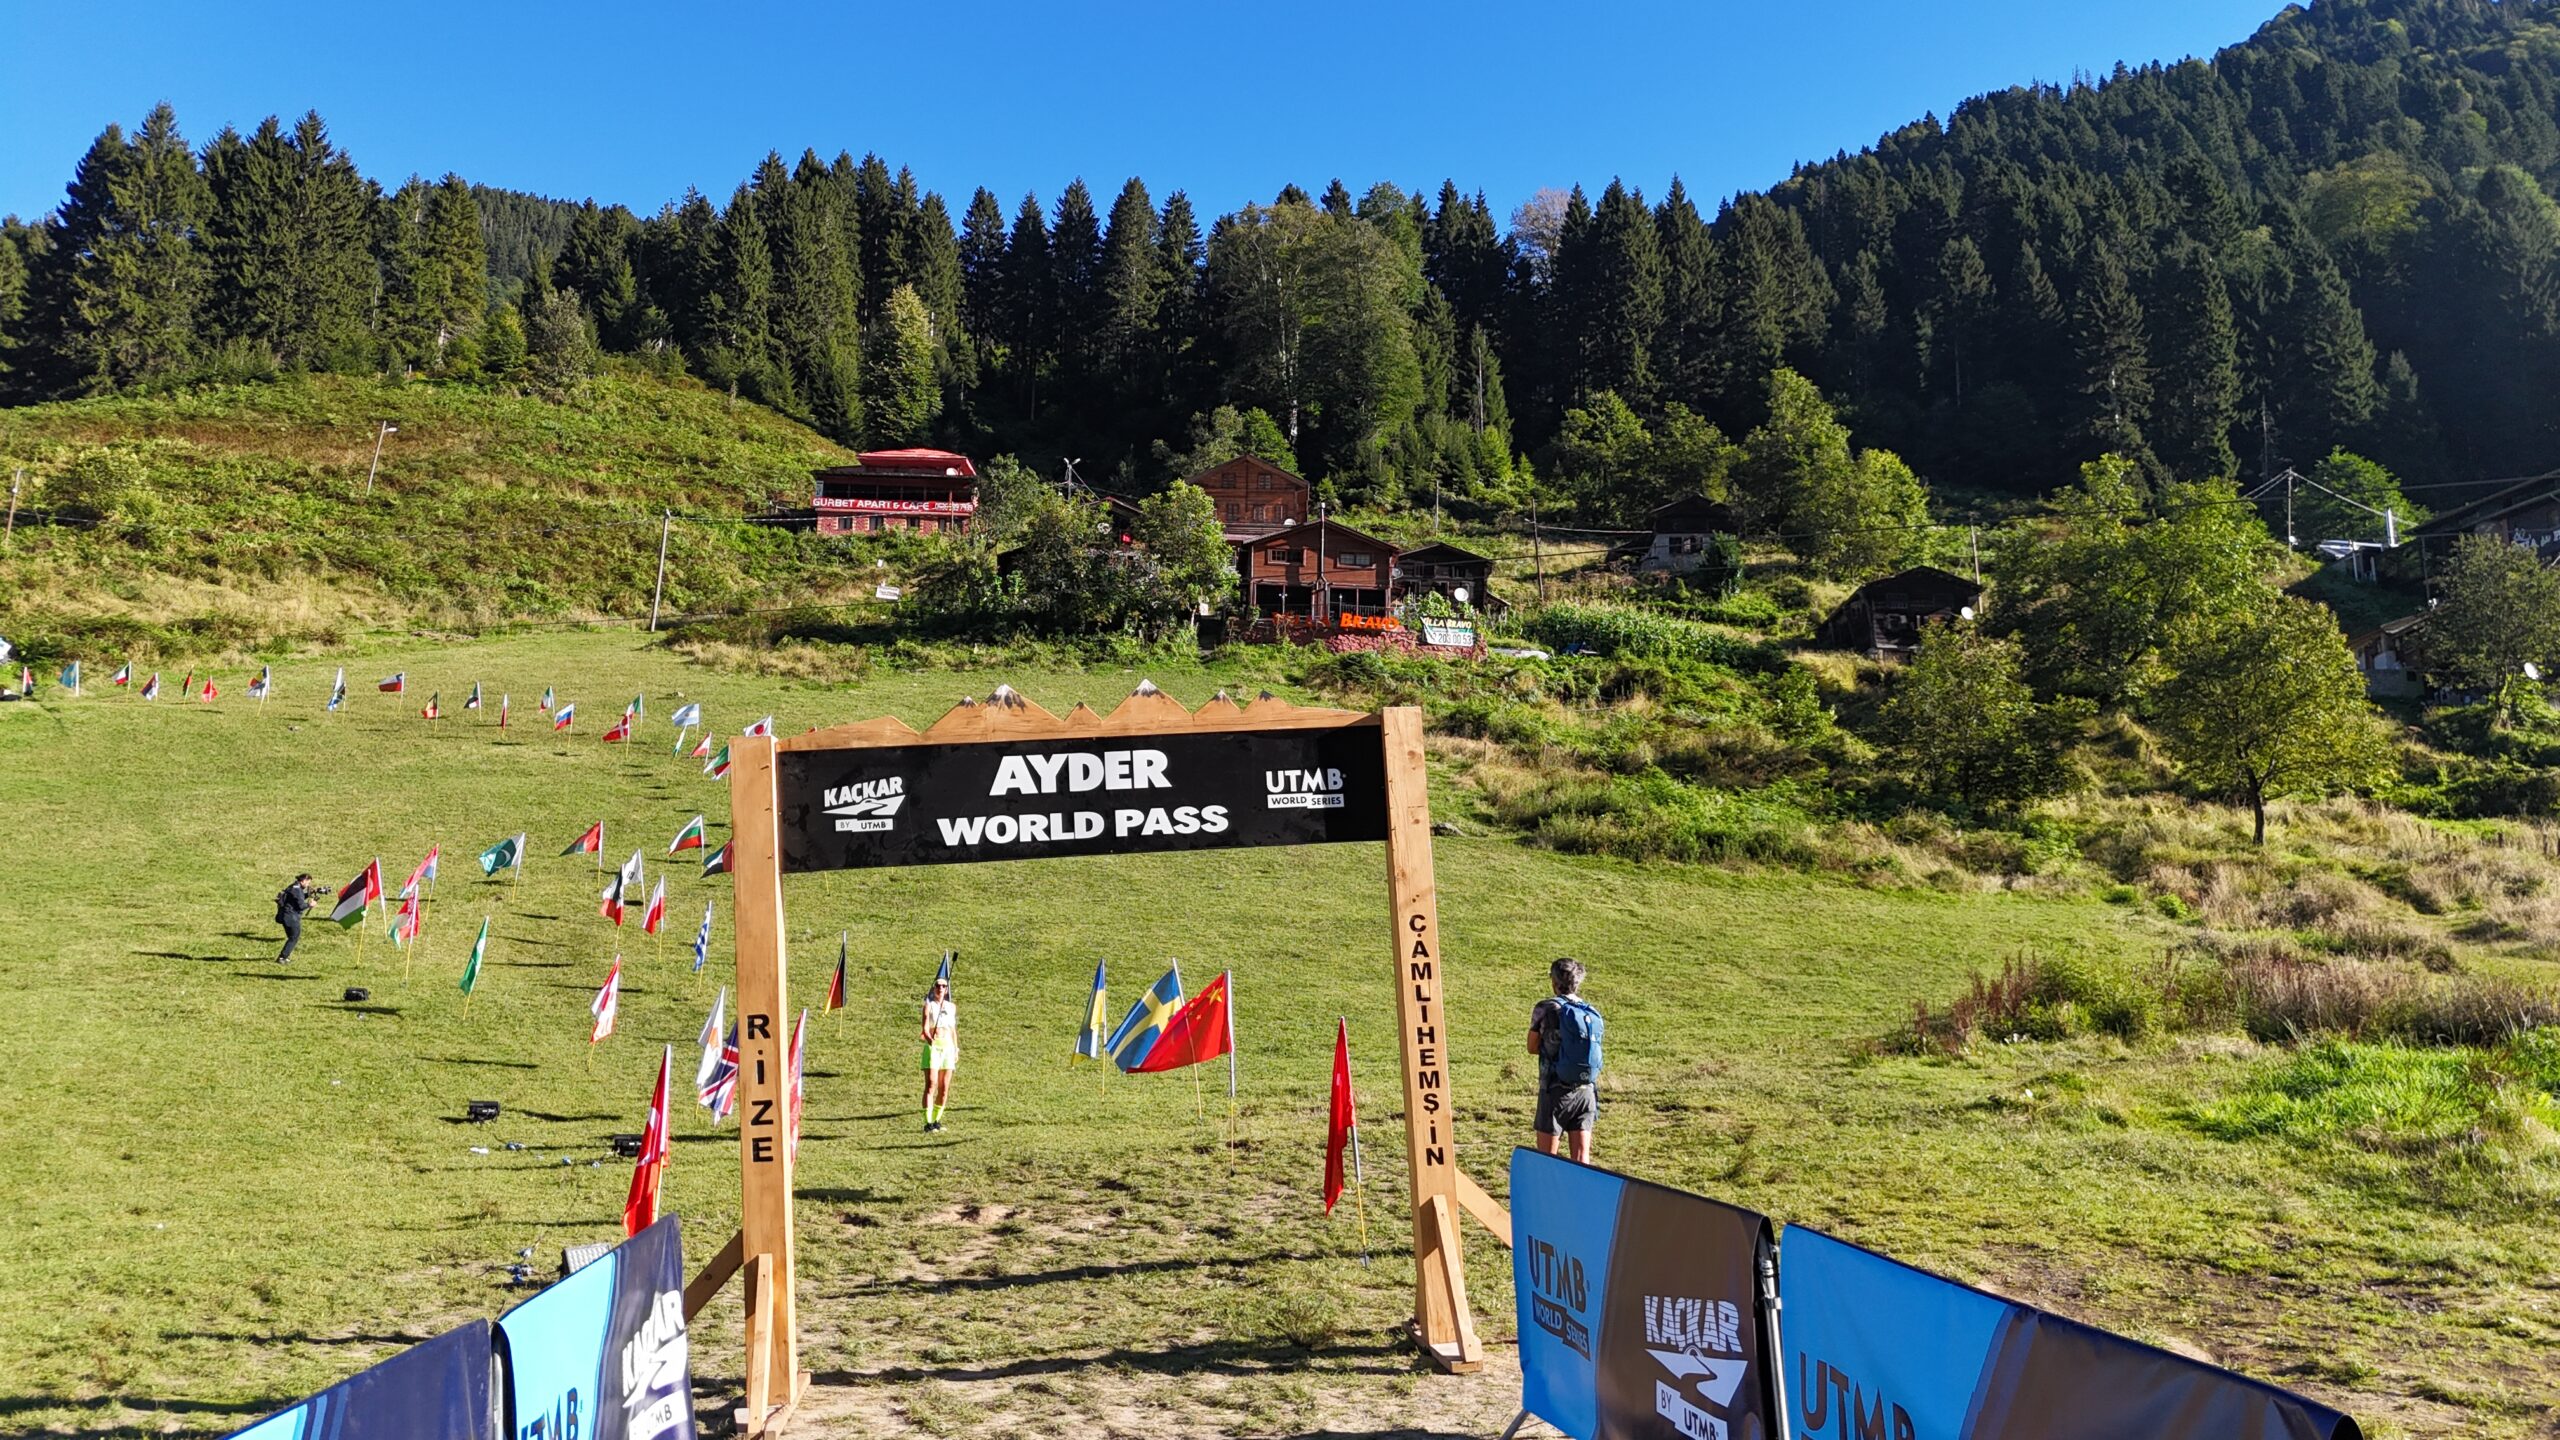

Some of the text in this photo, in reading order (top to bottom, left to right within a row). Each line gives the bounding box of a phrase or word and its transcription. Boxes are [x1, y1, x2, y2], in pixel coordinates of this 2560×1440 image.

[812, 497, 854, 507] GURBET
[856, 499, 891, 509] APART
[893, 501, 900, 509] &
[902, 501, 930, 510] CAFE
[989, 749, 1173, 796] AYDER
[1265, 767, 1344, 793] UTMB
[1271, 796, 1342, 806] WORLD SERIES
[840, 821, 887, 830] BY UTMB
[936, 805, 1229, 846] WORLD PASS
[1527, 1234, 1587, 1314] UTMB
[1534, 1301, 1588, 1352] WORLD SERIES
[1661, 1389, 1717, 1440] BY UTMB
